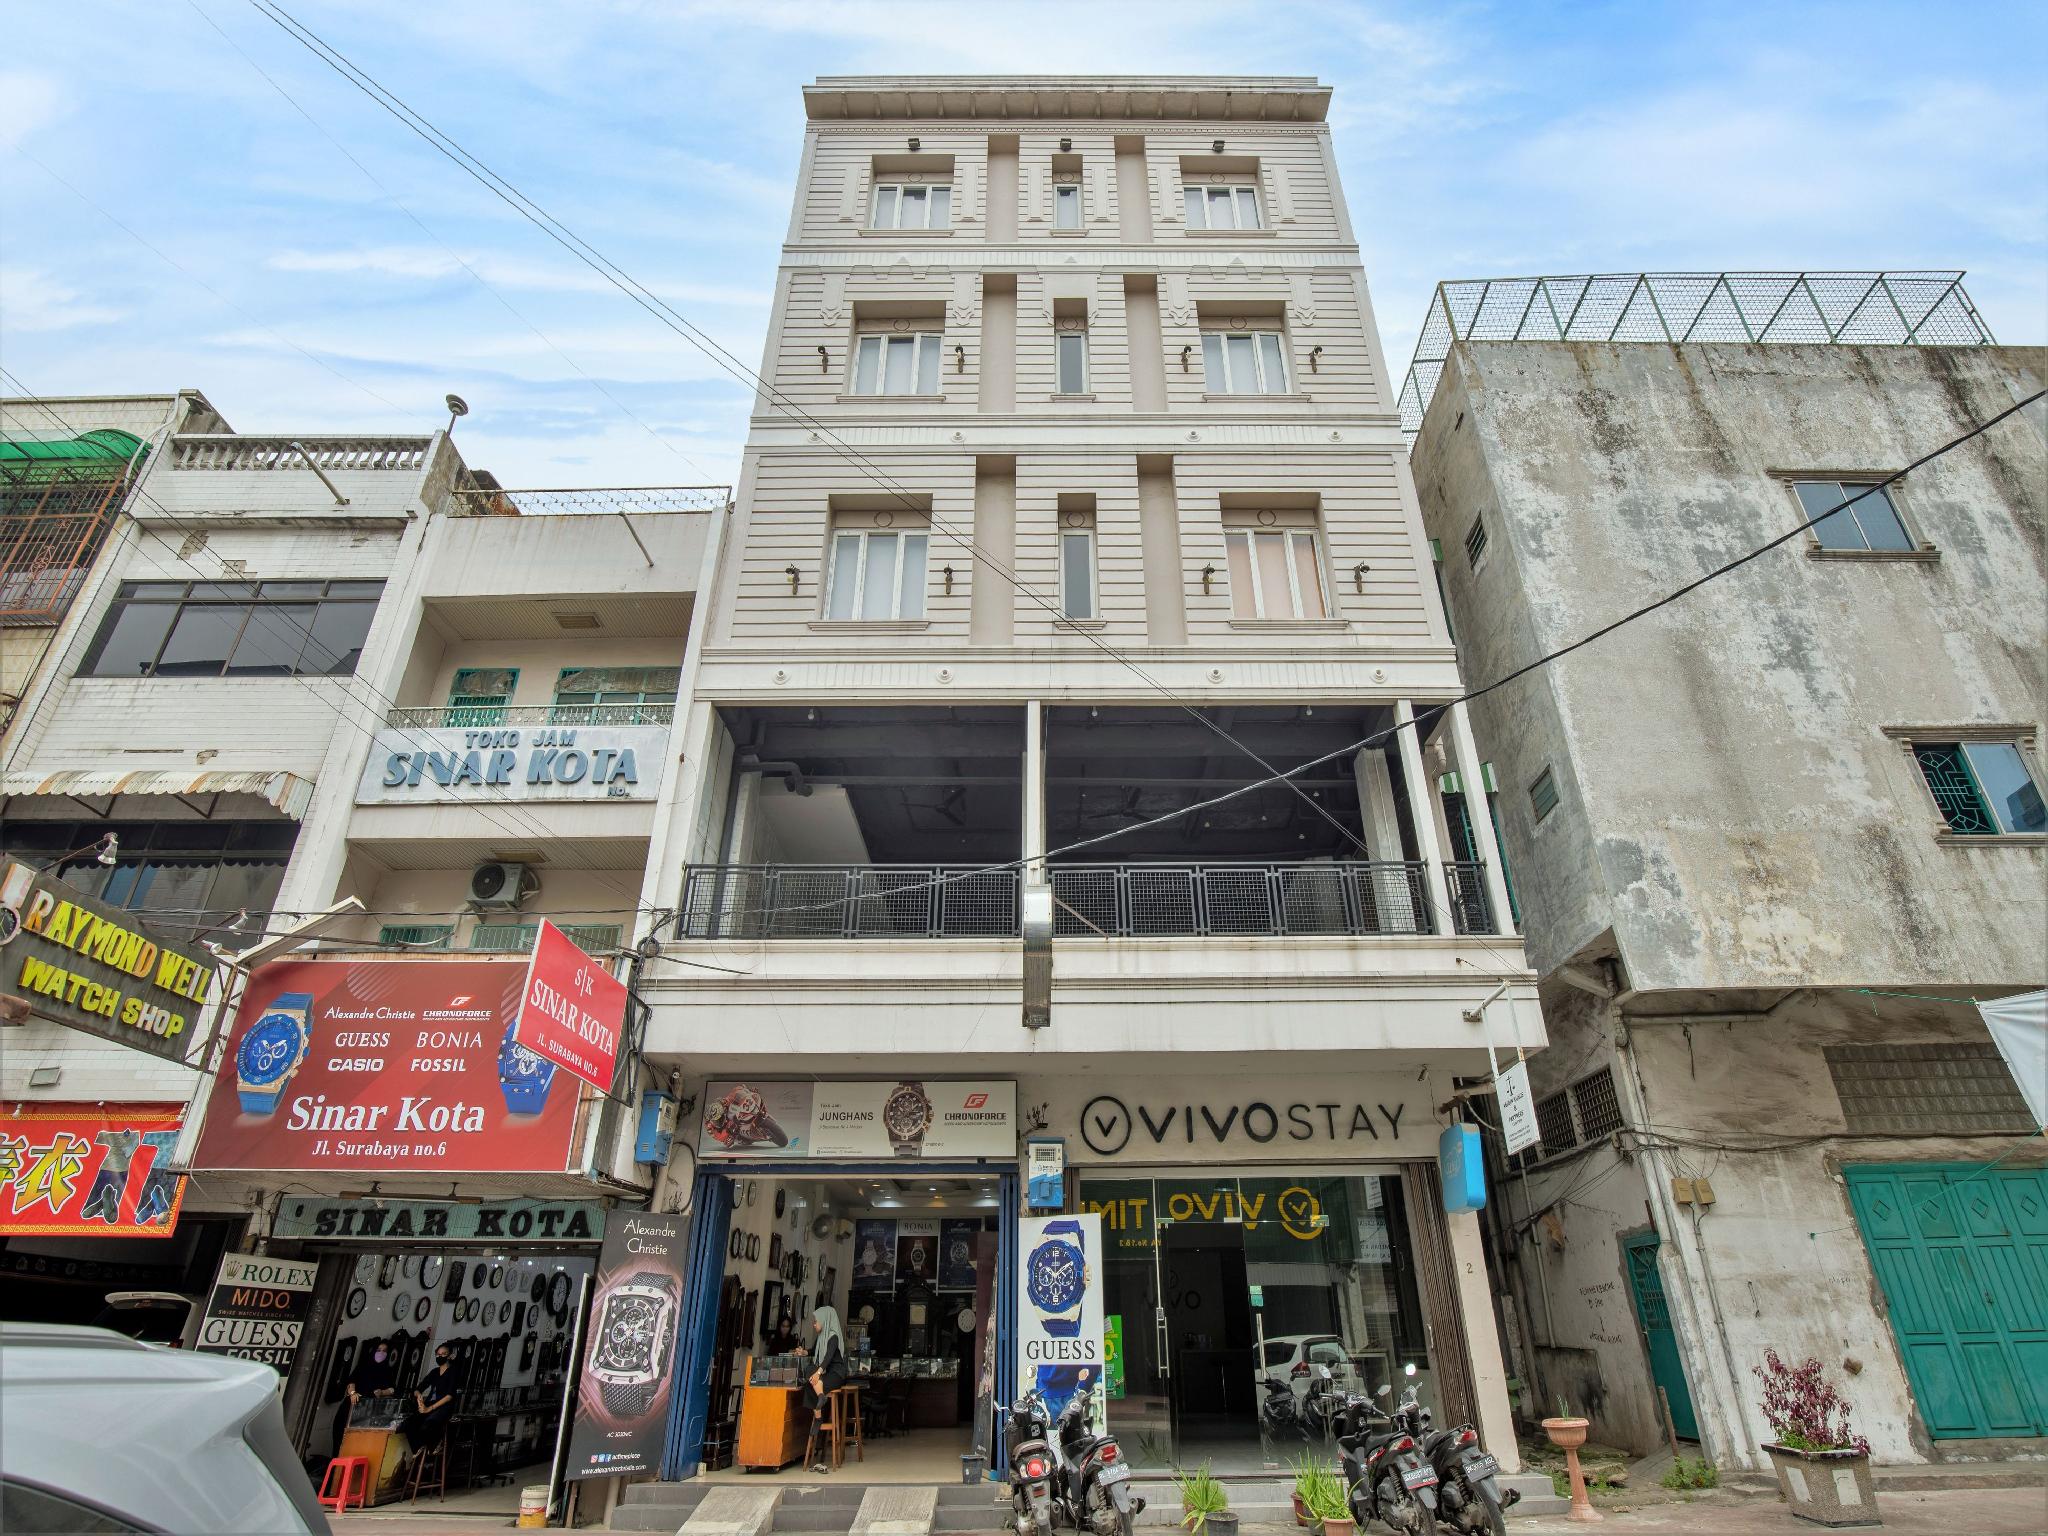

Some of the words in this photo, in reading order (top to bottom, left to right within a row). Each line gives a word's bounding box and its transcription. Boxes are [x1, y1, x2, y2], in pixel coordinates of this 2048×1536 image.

[465, 730, 520, 749] TOKO
[532, 730, 577, 747] JAM
[383, 750, 516, 787] SINAR
[526, 749, 638, 785] KOTA
[22, 888, 158, 979] RAYMOND
[153, 948, 213, 1005] WEIL
[18, 956, 121, 1019] WATCH
[121, 997, 185, 1039] SHOP
[324, 1006, 374, 1019] Alexandre
[376, 1006, 415, 1019] Christie
[530, 978, 578, 1033] SINAR
[578, 1011, 613, 1057] KOTA
[335, 1032, 390, 1047] GUESS
[416, 1031, 482, 1048] BONIA
[548, 1039, 582, 1069] SURABAYA
[327, 1058, 384, 1072] CASIO
[410, 1058, 467, 1072] FOSSIL
[286, 1094, 388, 1132] Sinar
[394, 1096, 485, 1132] Kota
[819, 1111, 874, 1121] JUNGHANS
[944, 1112, 1007, 1120] CHRONOFORCE
[1138, 1102, 1404, 1143] VIVOSTAY
[312, 1140, 330, 1156] Jl.
[336, 1139, 410, 1159] Surabaya
[413, 1140, 447, 1157] no.6
[314, 1208, 449, 1238] SINAR
[474, 1209, 592, 1238] KOTA
[623, 1218, 676, 1238] Alexandre
[903, 1222, 933, 1231] BONIA
[627, 1238, 668, 1255] Christie
[241, 1263, 315, 1286] ROLEX
[1466, 1262, 1473, 1274] 2
[231, 1288, 291, 1309] MIDO
[204, 1319, 299, 1347] GUESS
[1026, 1339, 1096, 1360] GUESS
